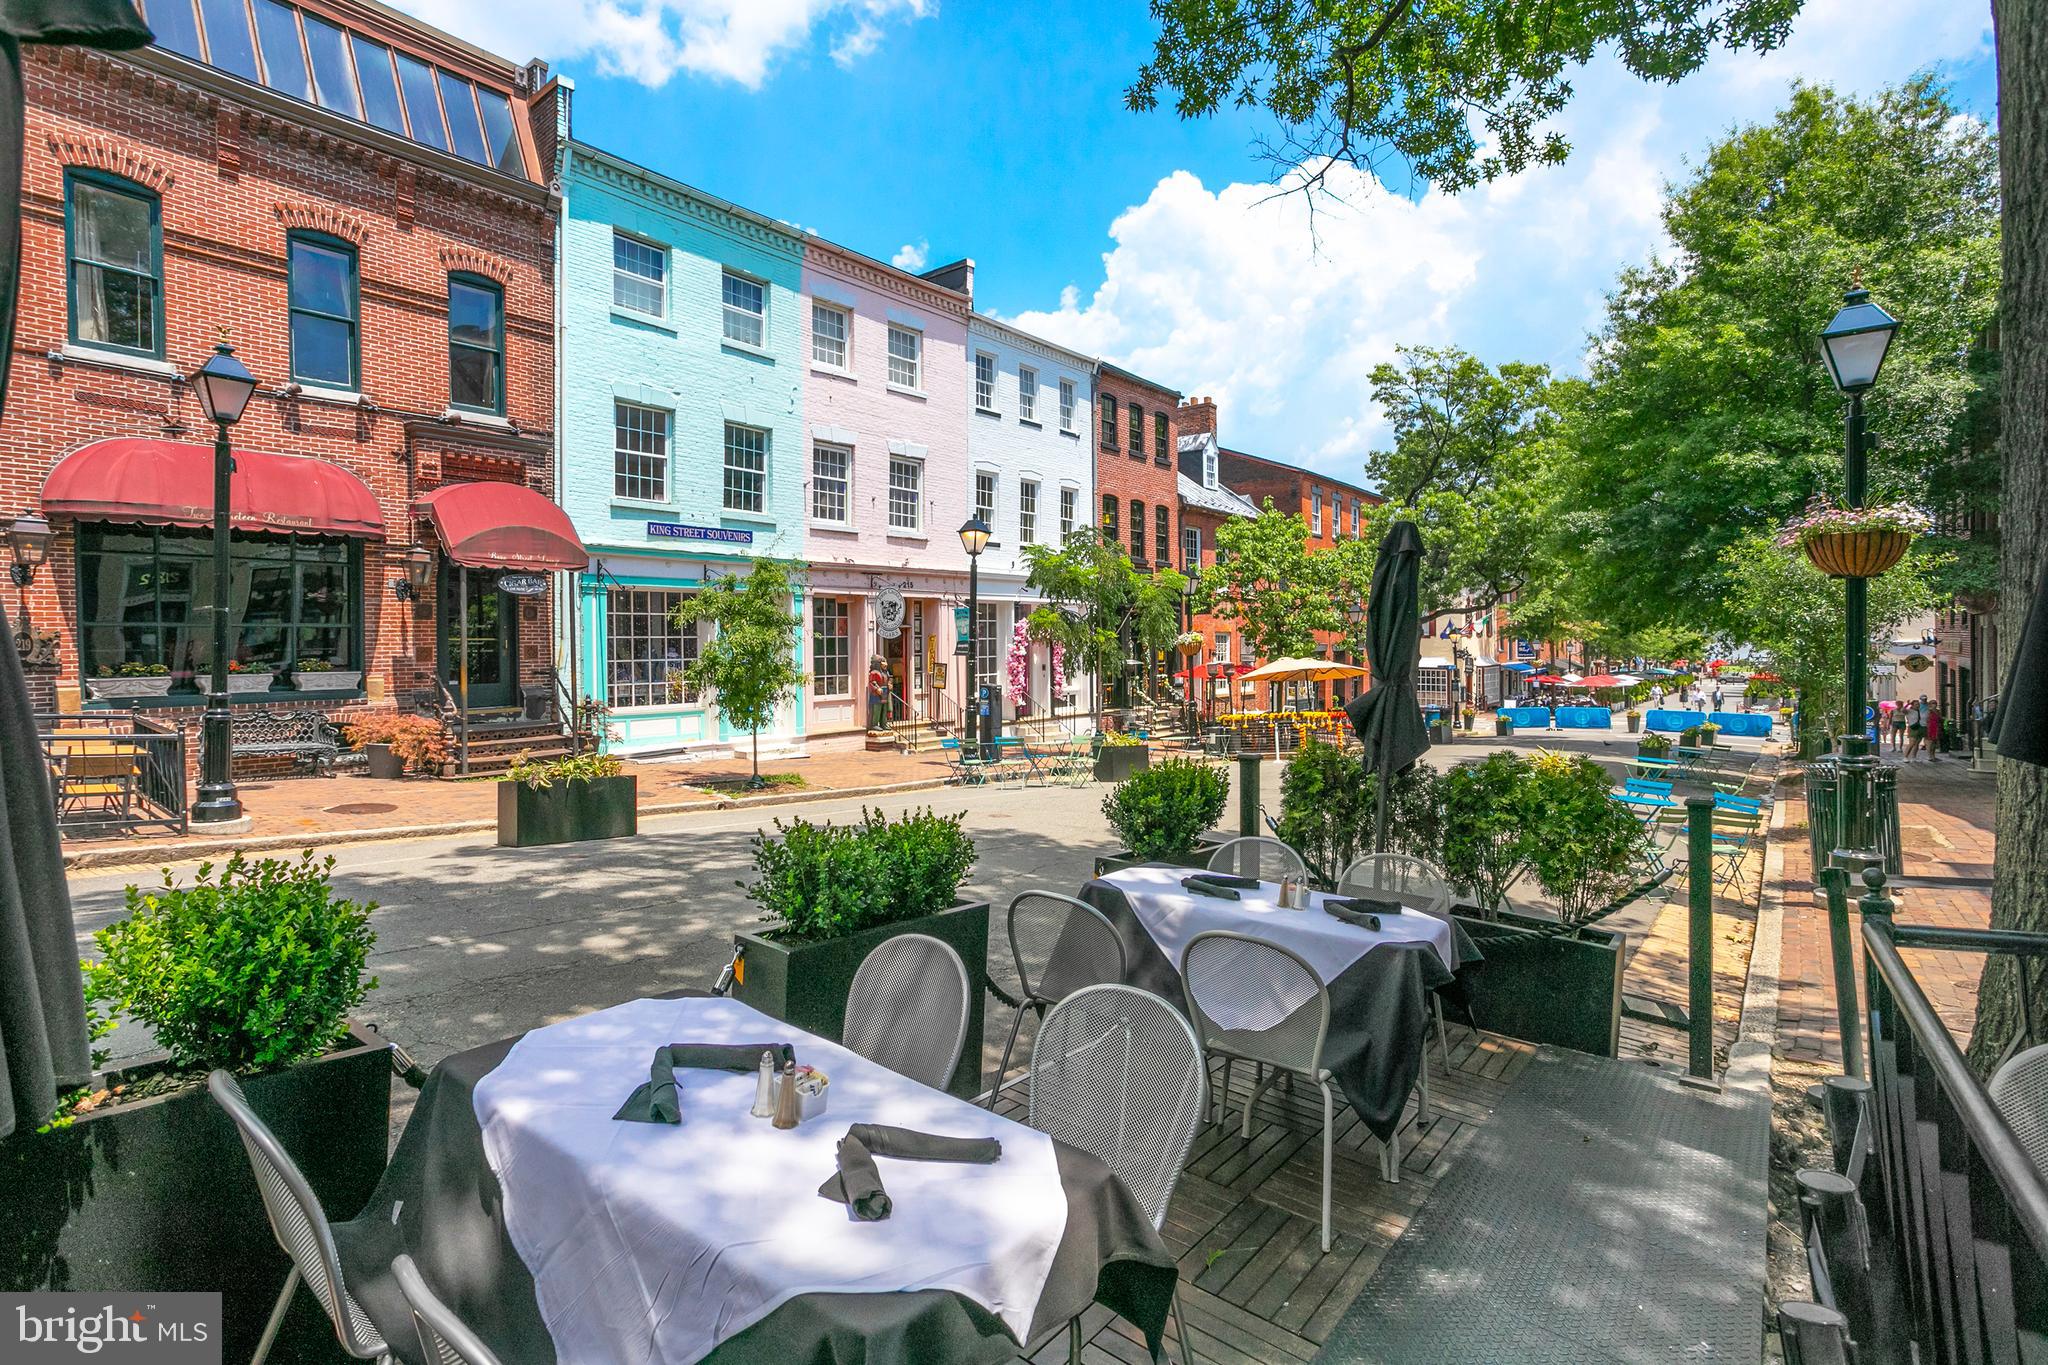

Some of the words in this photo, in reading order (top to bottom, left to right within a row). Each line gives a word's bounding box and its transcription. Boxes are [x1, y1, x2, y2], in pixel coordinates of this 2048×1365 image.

[650, 524, 671, 536] KING
[673, 527, 705, 538] STREET
[707, 530, 751, 542] SOUVENIRS
[16, 639, 30, 650] 219
